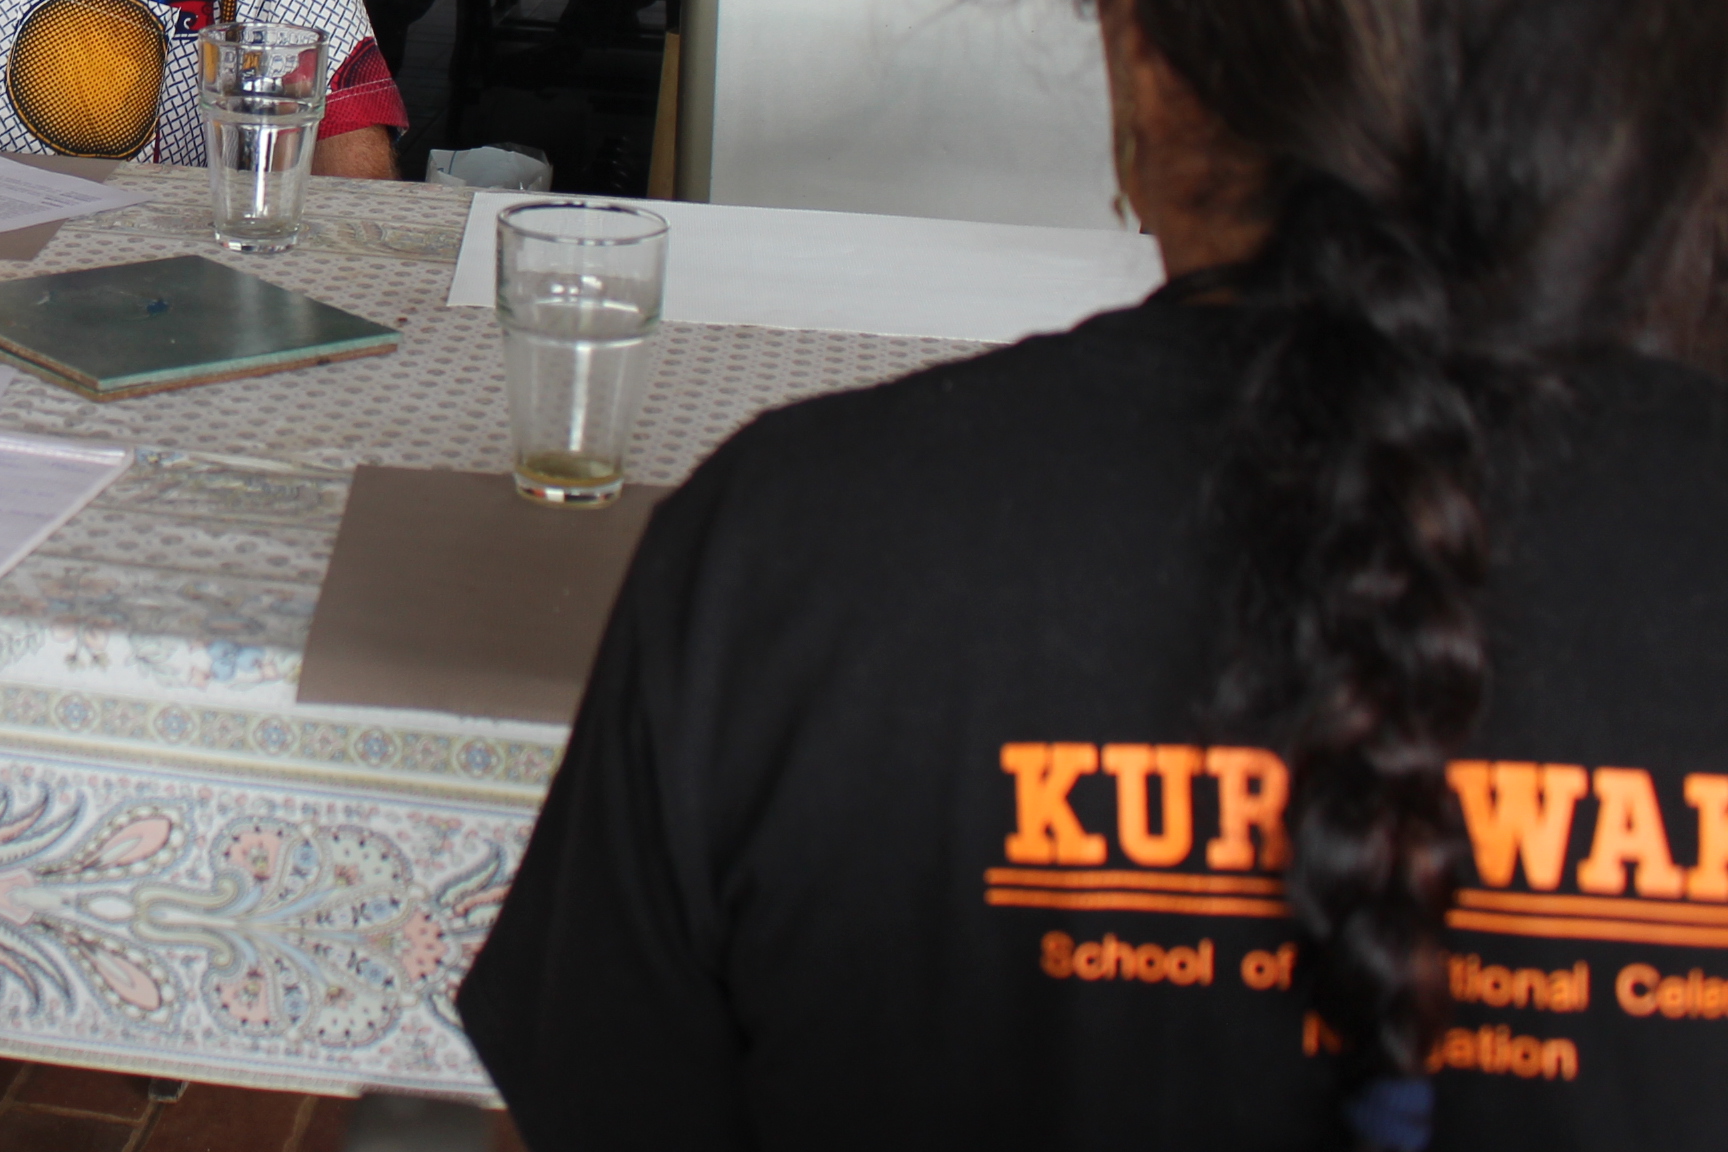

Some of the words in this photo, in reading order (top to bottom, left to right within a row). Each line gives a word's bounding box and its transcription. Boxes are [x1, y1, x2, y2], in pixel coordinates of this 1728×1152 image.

[999, 740, 1292, 871] KUR
[1040, 930, 1215, 988] School
[1240, 940, 1297, 991] of
[1446, 951, 1590, 1014] tional
[1615, 962, 1728, 1021] Cele
